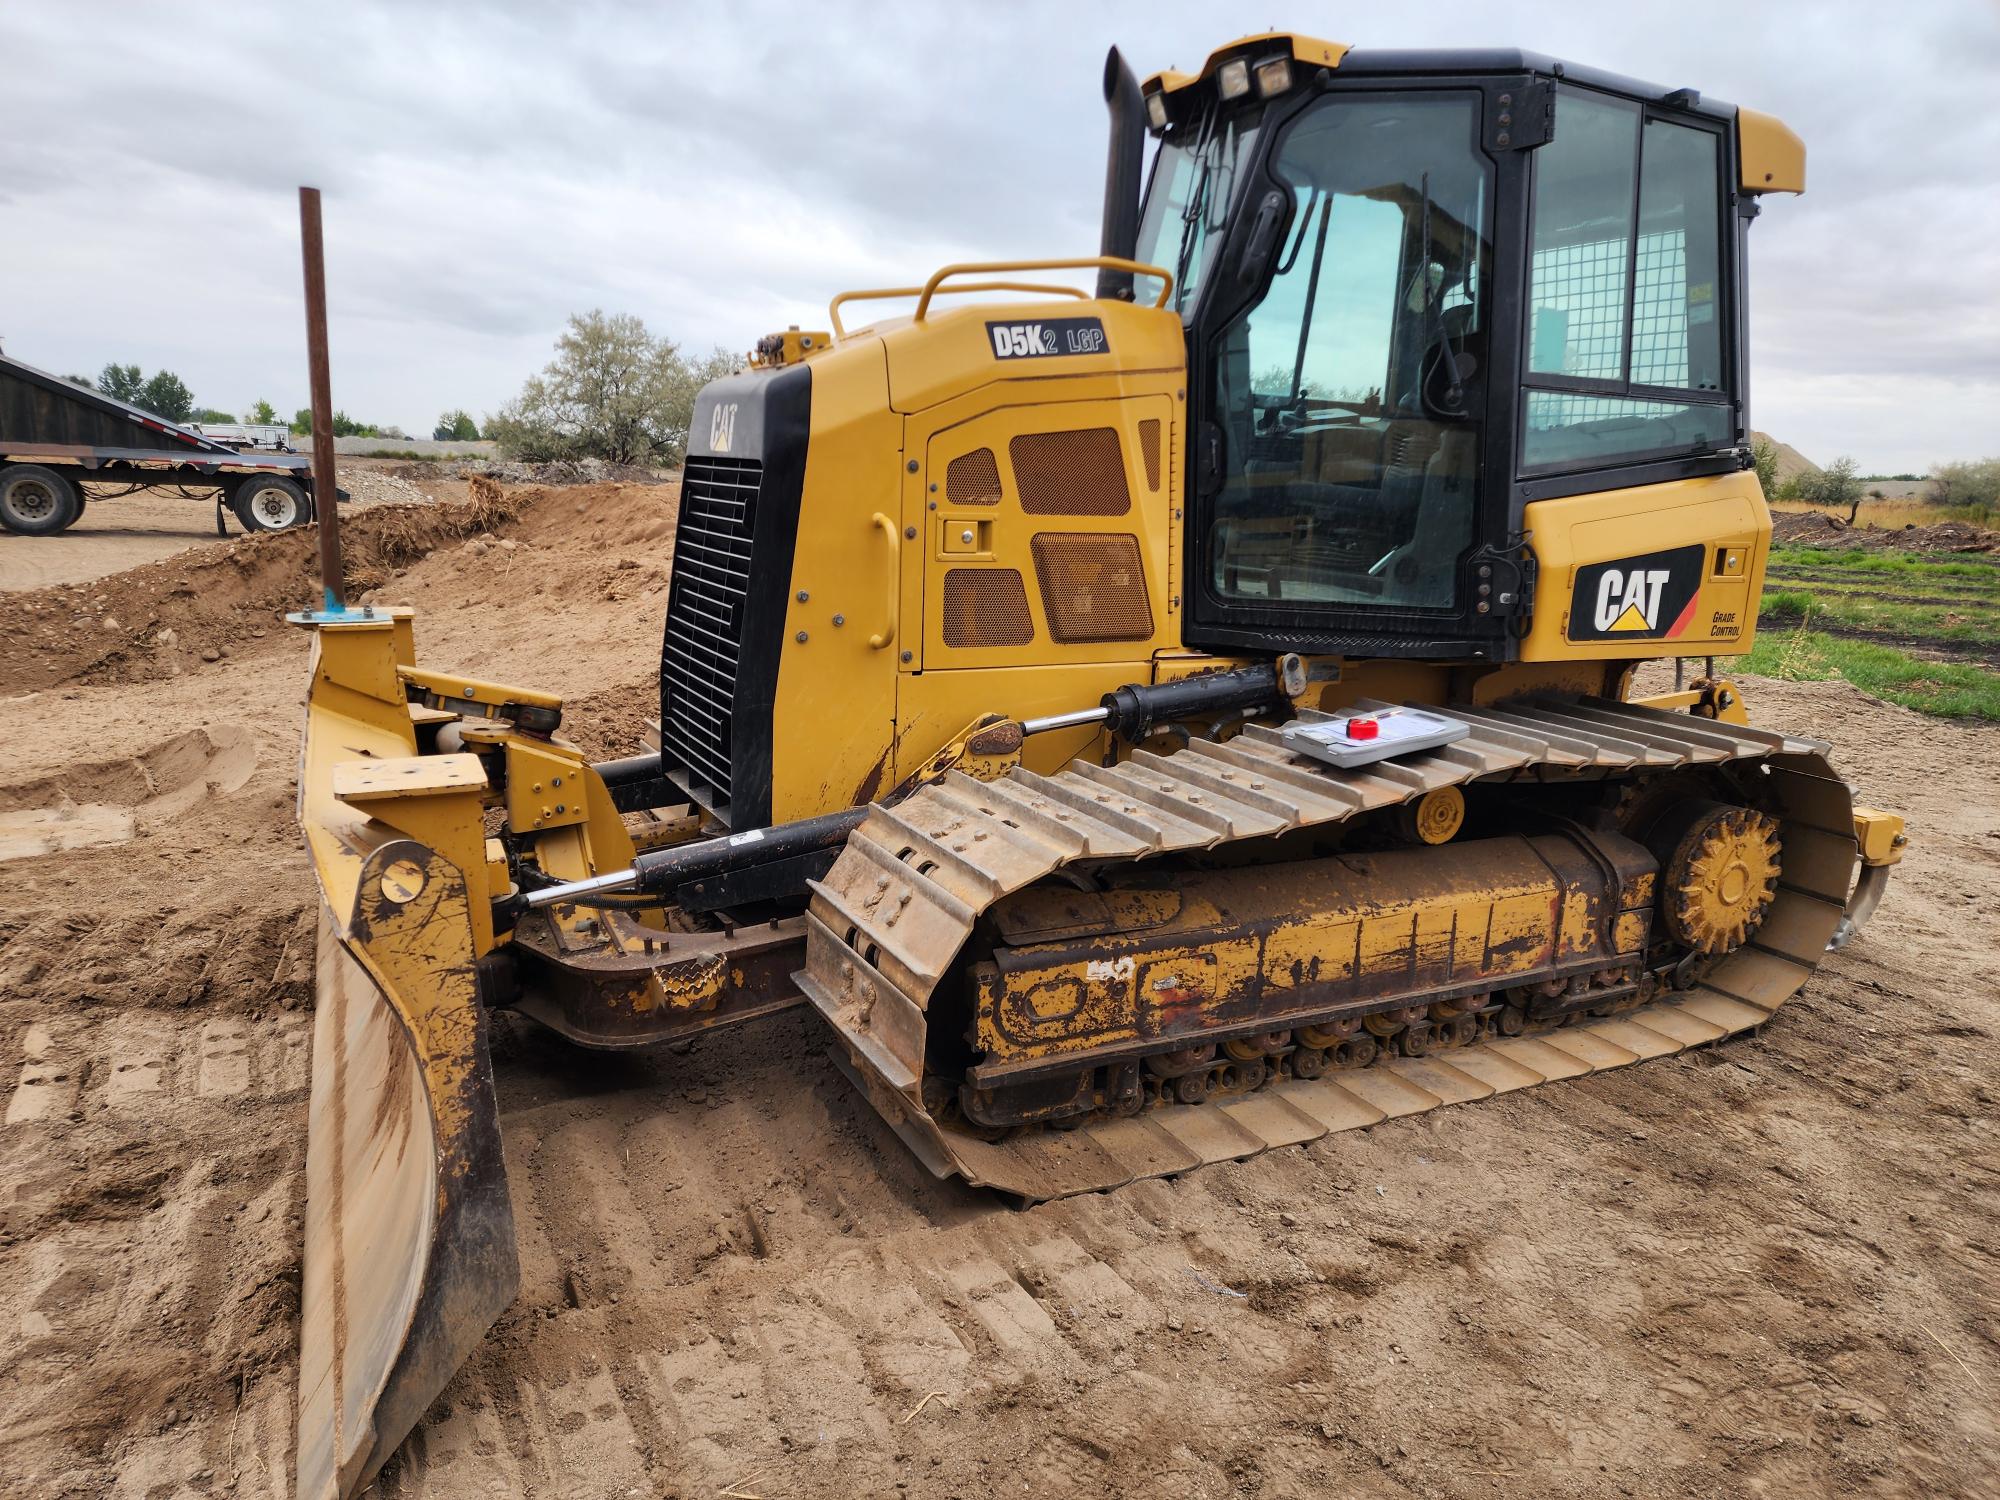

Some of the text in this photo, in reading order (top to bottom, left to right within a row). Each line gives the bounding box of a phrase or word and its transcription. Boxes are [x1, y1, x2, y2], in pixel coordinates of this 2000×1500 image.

[1067, 329, 1104, 353] LGP
[710, 403, 738, 452] CAT
[1594, 569, 1671, 632] CAT
[1712, 611, 1736, 623] GRADE
[1710, 624, 1740, 637] CONTROL
